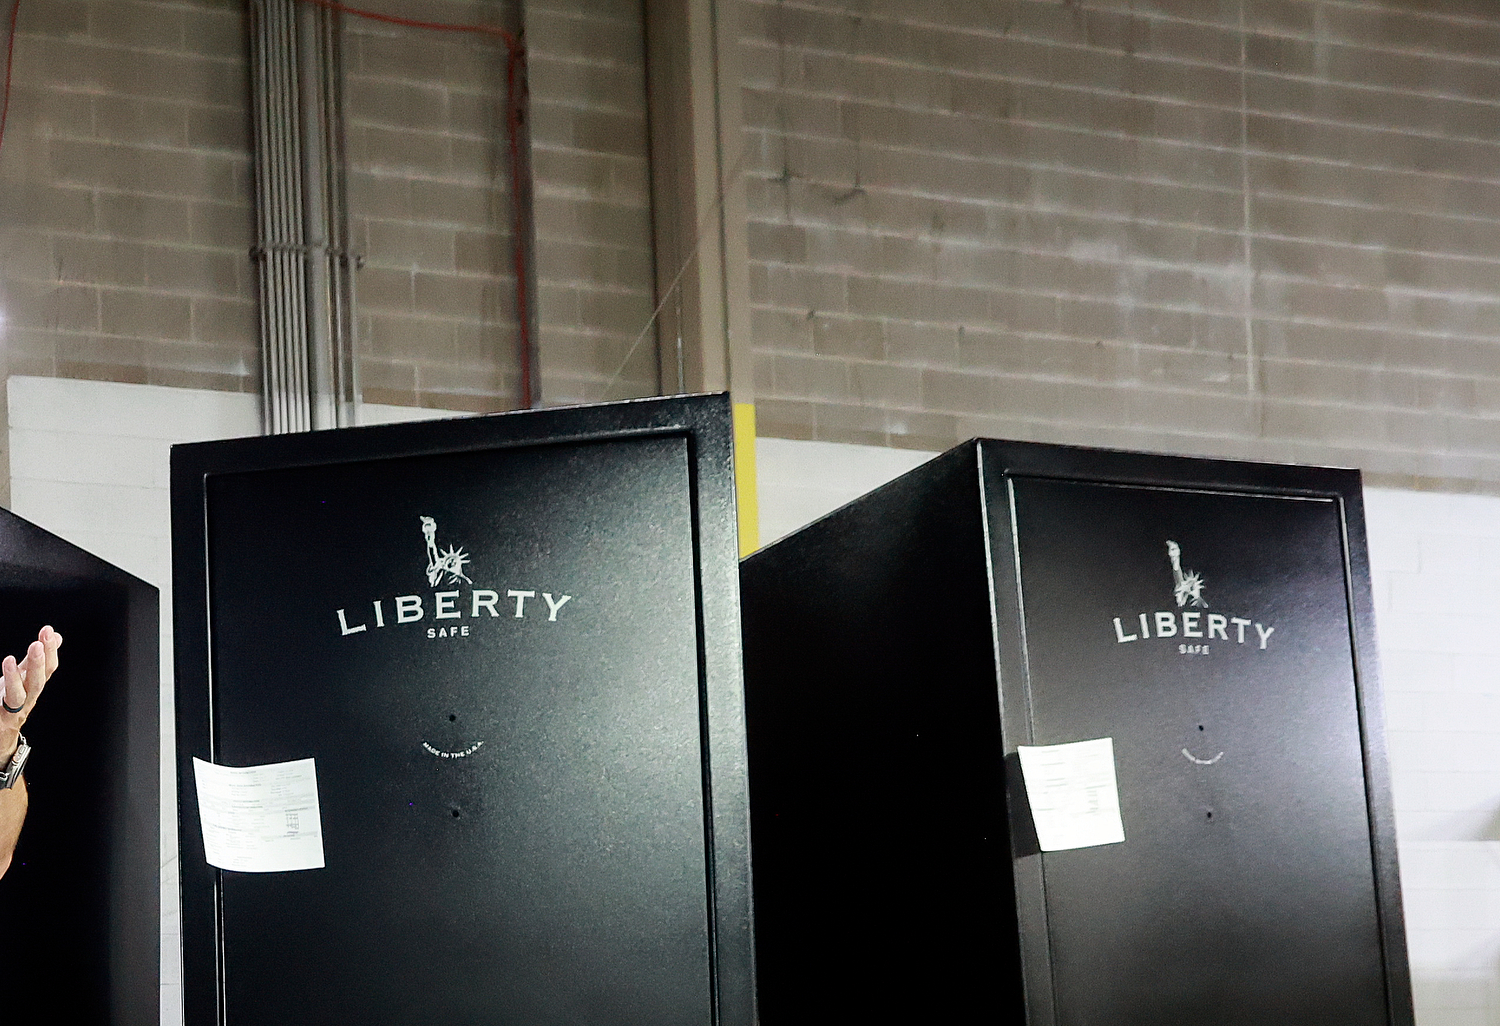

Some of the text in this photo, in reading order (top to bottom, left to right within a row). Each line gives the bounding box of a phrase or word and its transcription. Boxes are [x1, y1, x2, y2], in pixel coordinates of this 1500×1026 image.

[336, 589, 572, 636] LIBERTY
[426, 625, 470, 639] SAFE
[1112, 611, 1275, 650] LIBERTY
